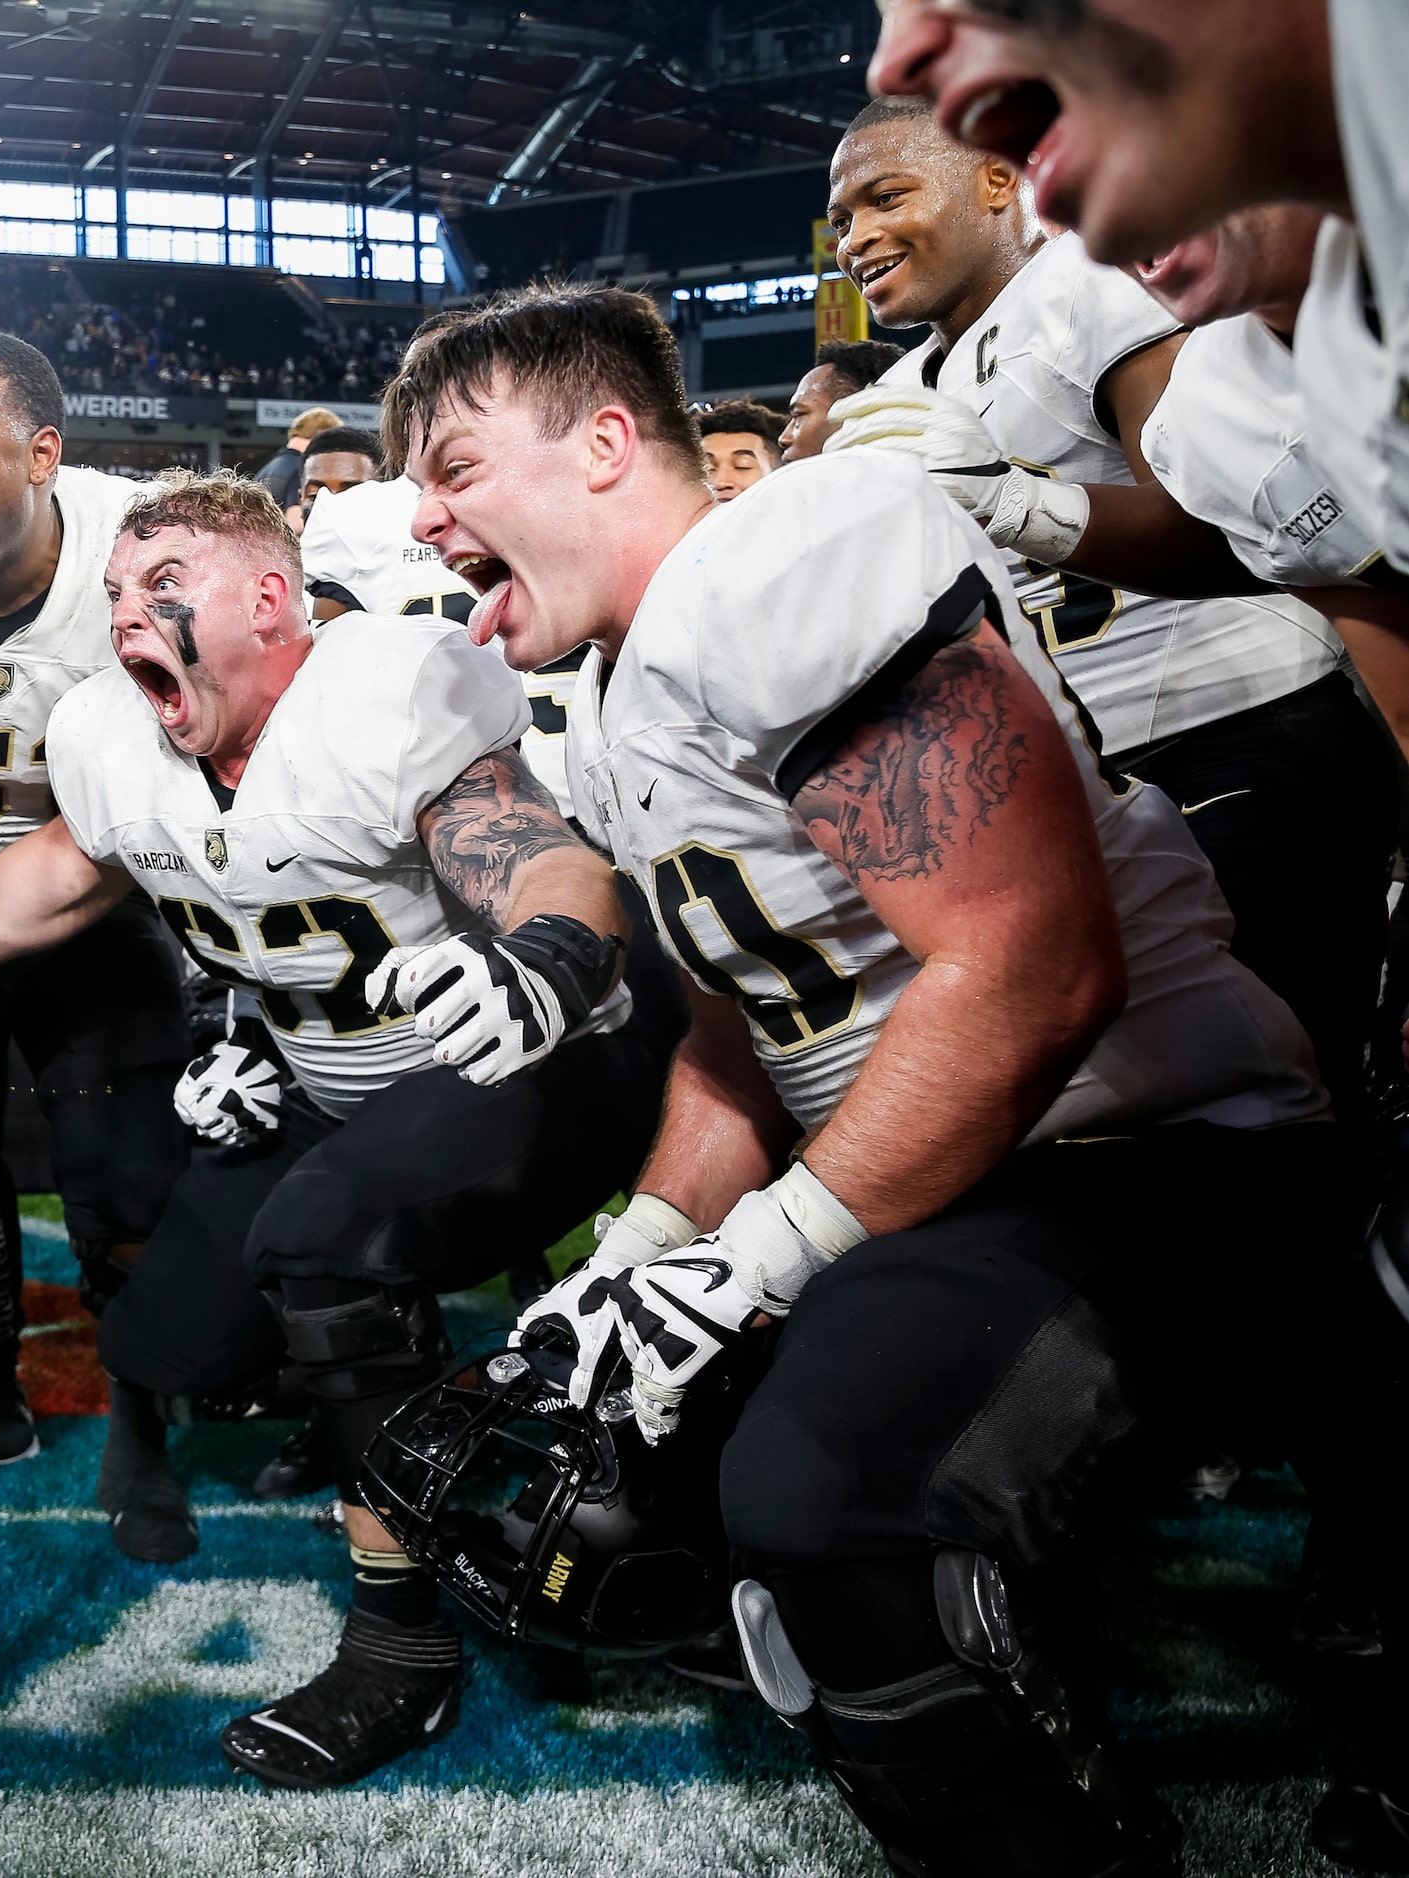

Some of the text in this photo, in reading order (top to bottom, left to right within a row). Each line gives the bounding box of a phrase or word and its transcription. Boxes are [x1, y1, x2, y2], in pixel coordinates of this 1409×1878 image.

[975, 324, 1001, 386] C
[65, 395, 169, 419] WERADE
[402, 547, 440, 563] PEARS
[132, 842, 189, 874] BARCZAK
[156, 893, 416, 1039] 62
[454, 1552, 488, 1590] BLACK
[541, 1551, 573, 1602] ARMY
